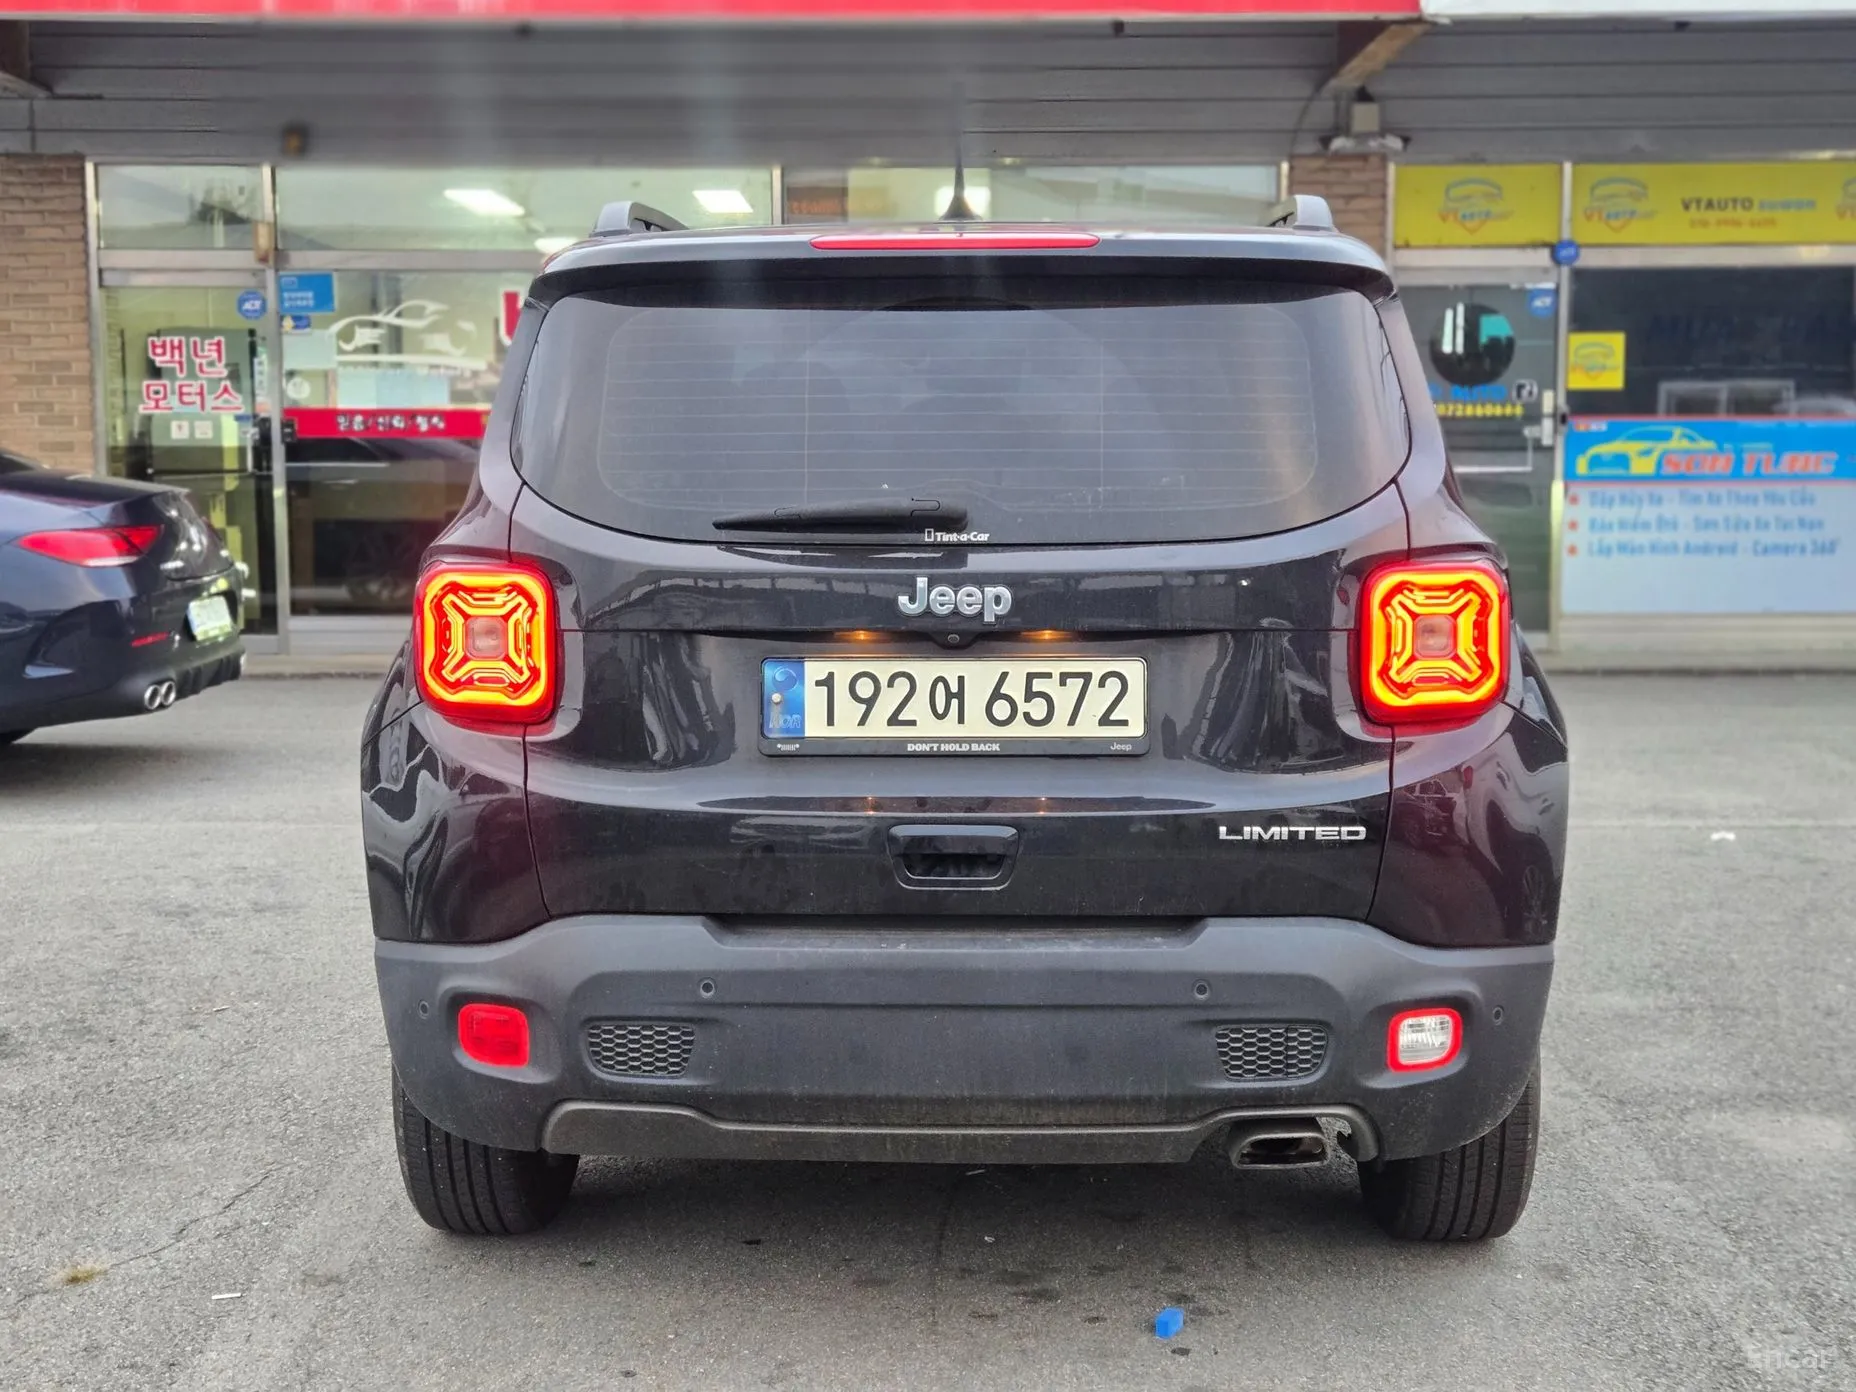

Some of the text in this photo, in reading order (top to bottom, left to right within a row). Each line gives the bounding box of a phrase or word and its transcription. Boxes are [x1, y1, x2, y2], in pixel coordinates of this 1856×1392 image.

[1680, 196, 1754, 212] VTAUTO
[148, 335, 228, 378] 백년
[138, 380, 244, 413] 모터스
[897, 576, 1012, 623] Jeep
[814, 670, 1130, 728] 192어 6572
[906, 742, 1001, 752] DON'T HOLD BACK
[1109, 741, 1133, 752] Jeep
[1218, 825, 1367, 841] LIMITED
